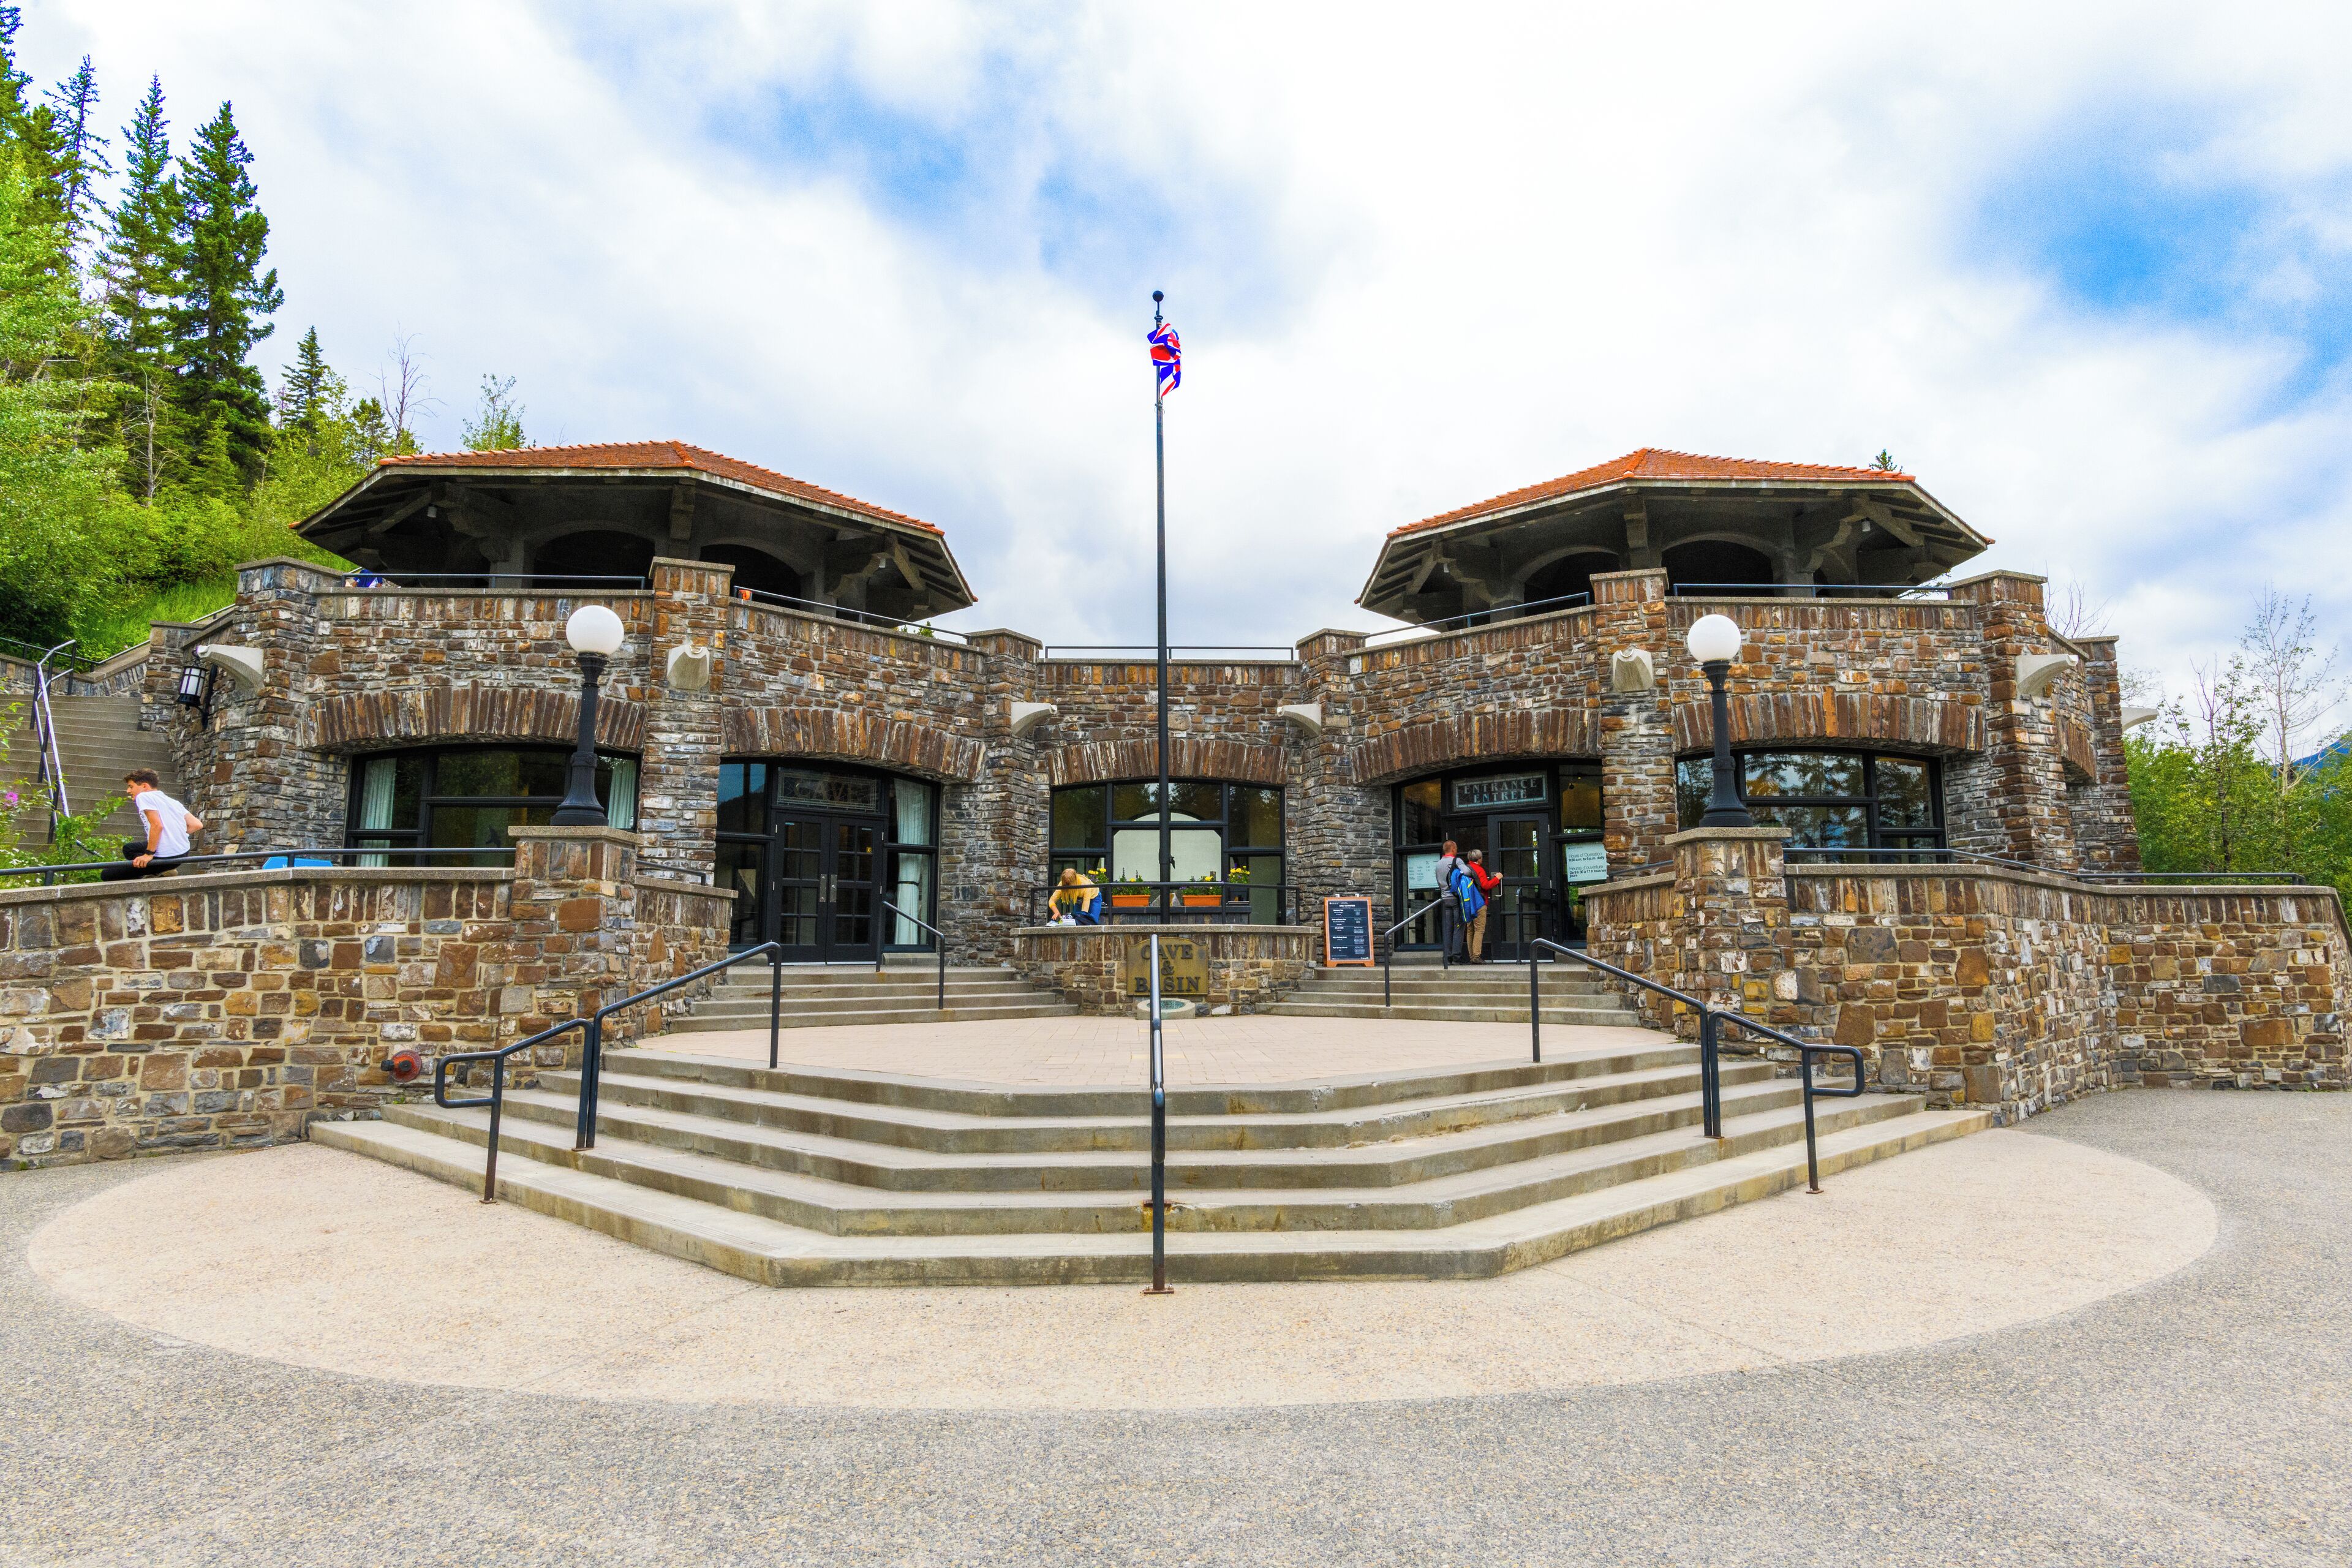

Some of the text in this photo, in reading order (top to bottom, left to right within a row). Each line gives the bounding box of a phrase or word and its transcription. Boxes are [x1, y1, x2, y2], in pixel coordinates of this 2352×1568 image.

[1464, 778, 1537, 794] ENTRANCE
[1140, 944, 1193, 960] CAVE
[1161, 960, 1175, 976] &
[1134, 976, 1200, 992] BSIN
